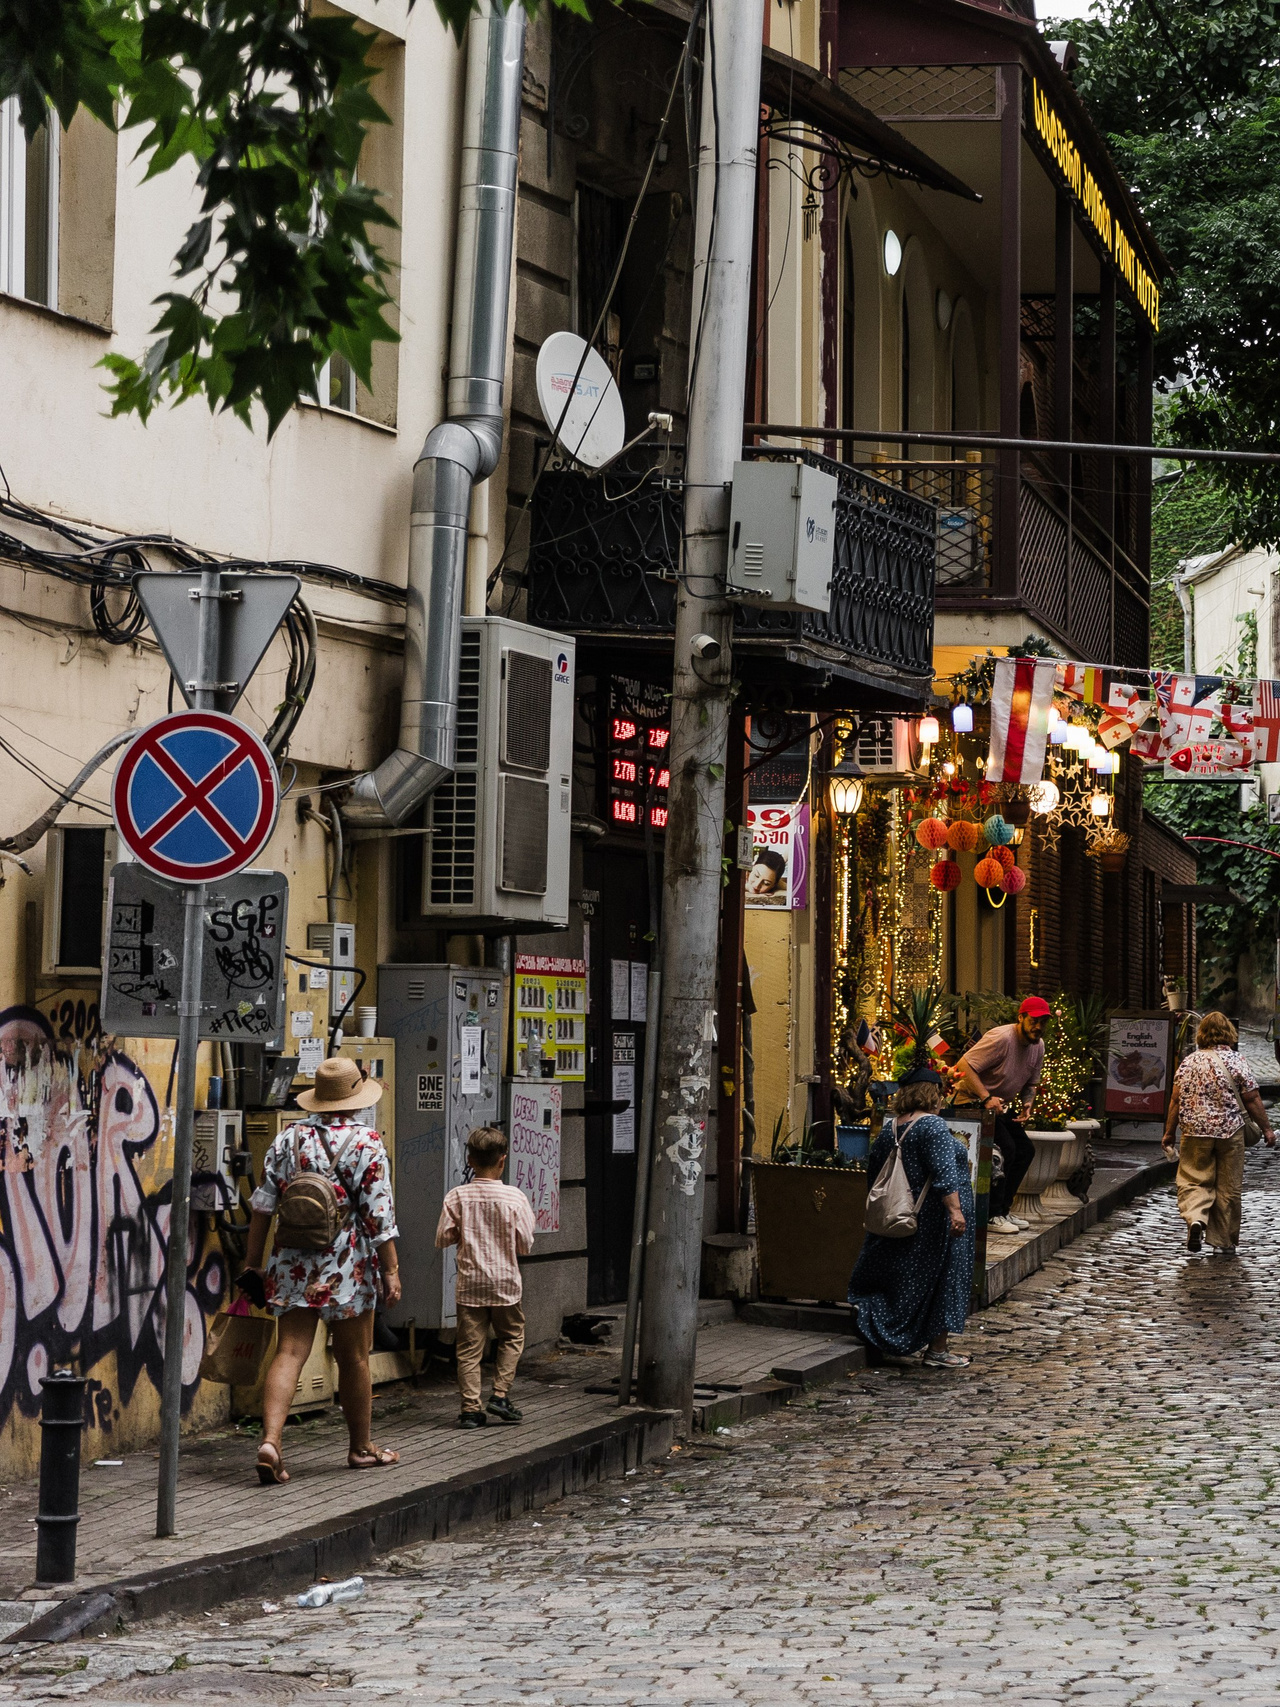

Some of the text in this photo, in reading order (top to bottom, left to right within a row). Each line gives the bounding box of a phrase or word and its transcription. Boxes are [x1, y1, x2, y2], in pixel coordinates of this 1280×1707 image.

[1115, 219, 1136, 291] POINT
[1136, 258, 1159, 333] HOTEL
[554, 673, 570, 685] GREE
[1126, 1032, 1153, 1041] English
[1121, 1040, 1158, 1049] Breakfast
[418, 1075, 443, 1092] BNE
[418, 1091, 443, 1100] WAS
[418, 1101, 443, 1110] HERE
